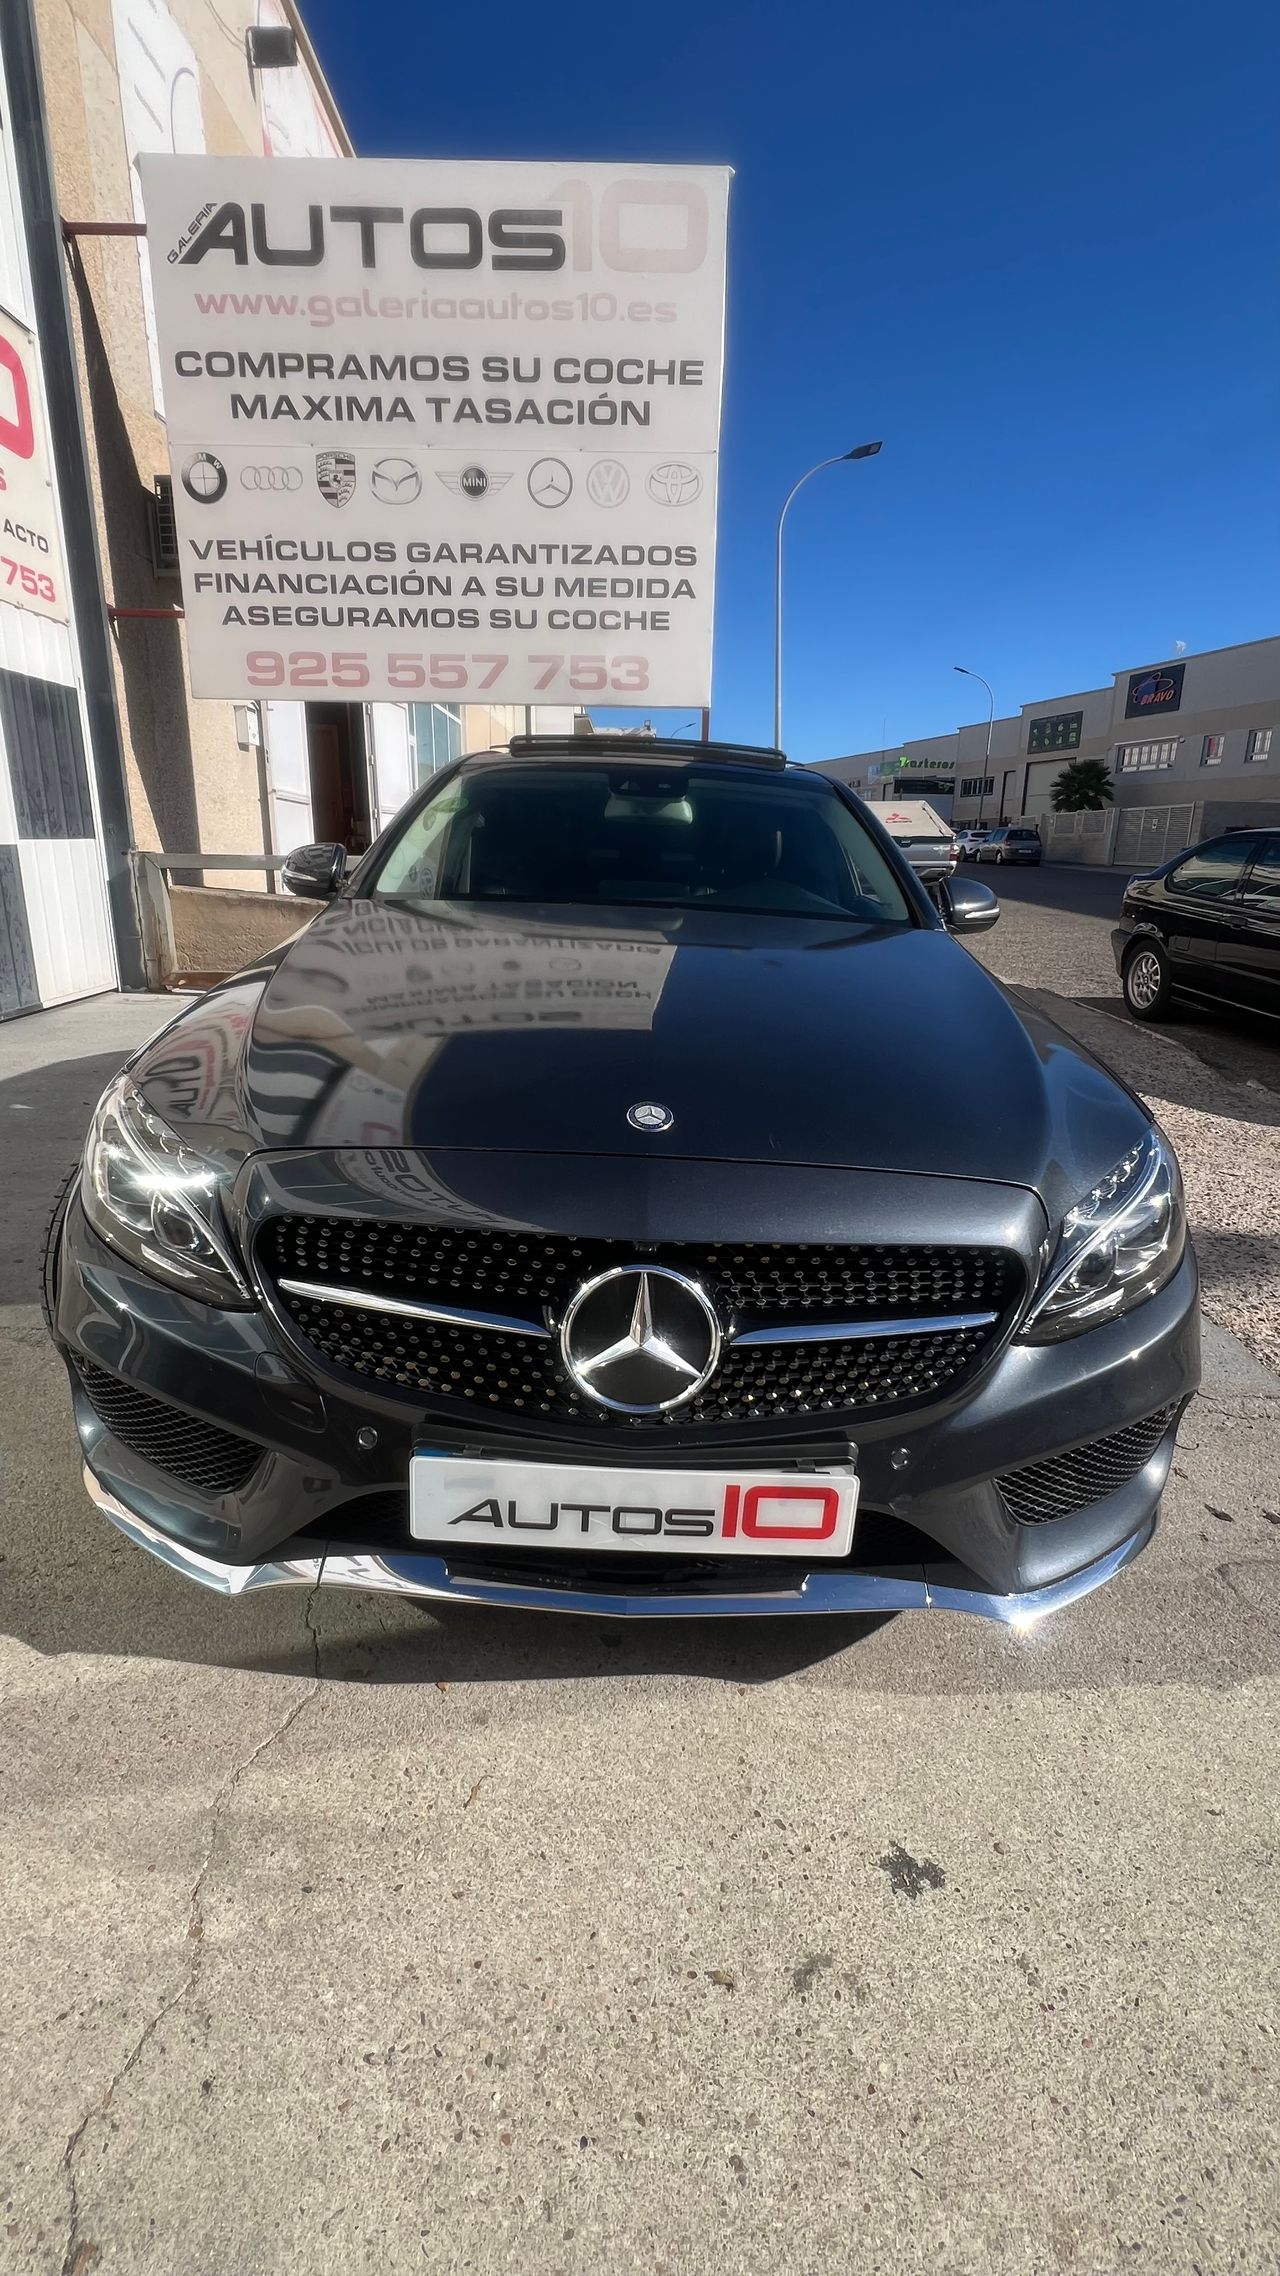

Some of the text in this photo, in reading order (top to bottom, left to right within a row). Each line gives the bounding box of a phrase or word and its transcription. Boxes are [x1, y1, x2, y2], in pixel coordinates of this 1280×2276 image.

[167, 202, 218, 264] GALERIA
[178, 178, 709, 274] AUTOS10
[194, 288, 678, 328] www.galeriaautos10.es
[174, 350, 704, 385] COMPRAMOS SU COCHE
[230, 392, 650, 425] MAXIMA TASACIÓN
[462, 476, 487, 488] MINI
[4, 518, 50, 554] ACTO
[188, 534, 697, 566] VEHÍCULOS GARANTIZADOS
[1, 556, 57, 603] 753
[194, 569, 696, 599] FINANCIACIÓN A SU MEDIDA
[222, 605, 670, 631] ASEGURAMOS SU COCHE
[246, 651, 649, 691] 925 557 753
[1140, 688, 1175, 706] BRAVO
[446, 1484, 840, 1541] AUTOS10
